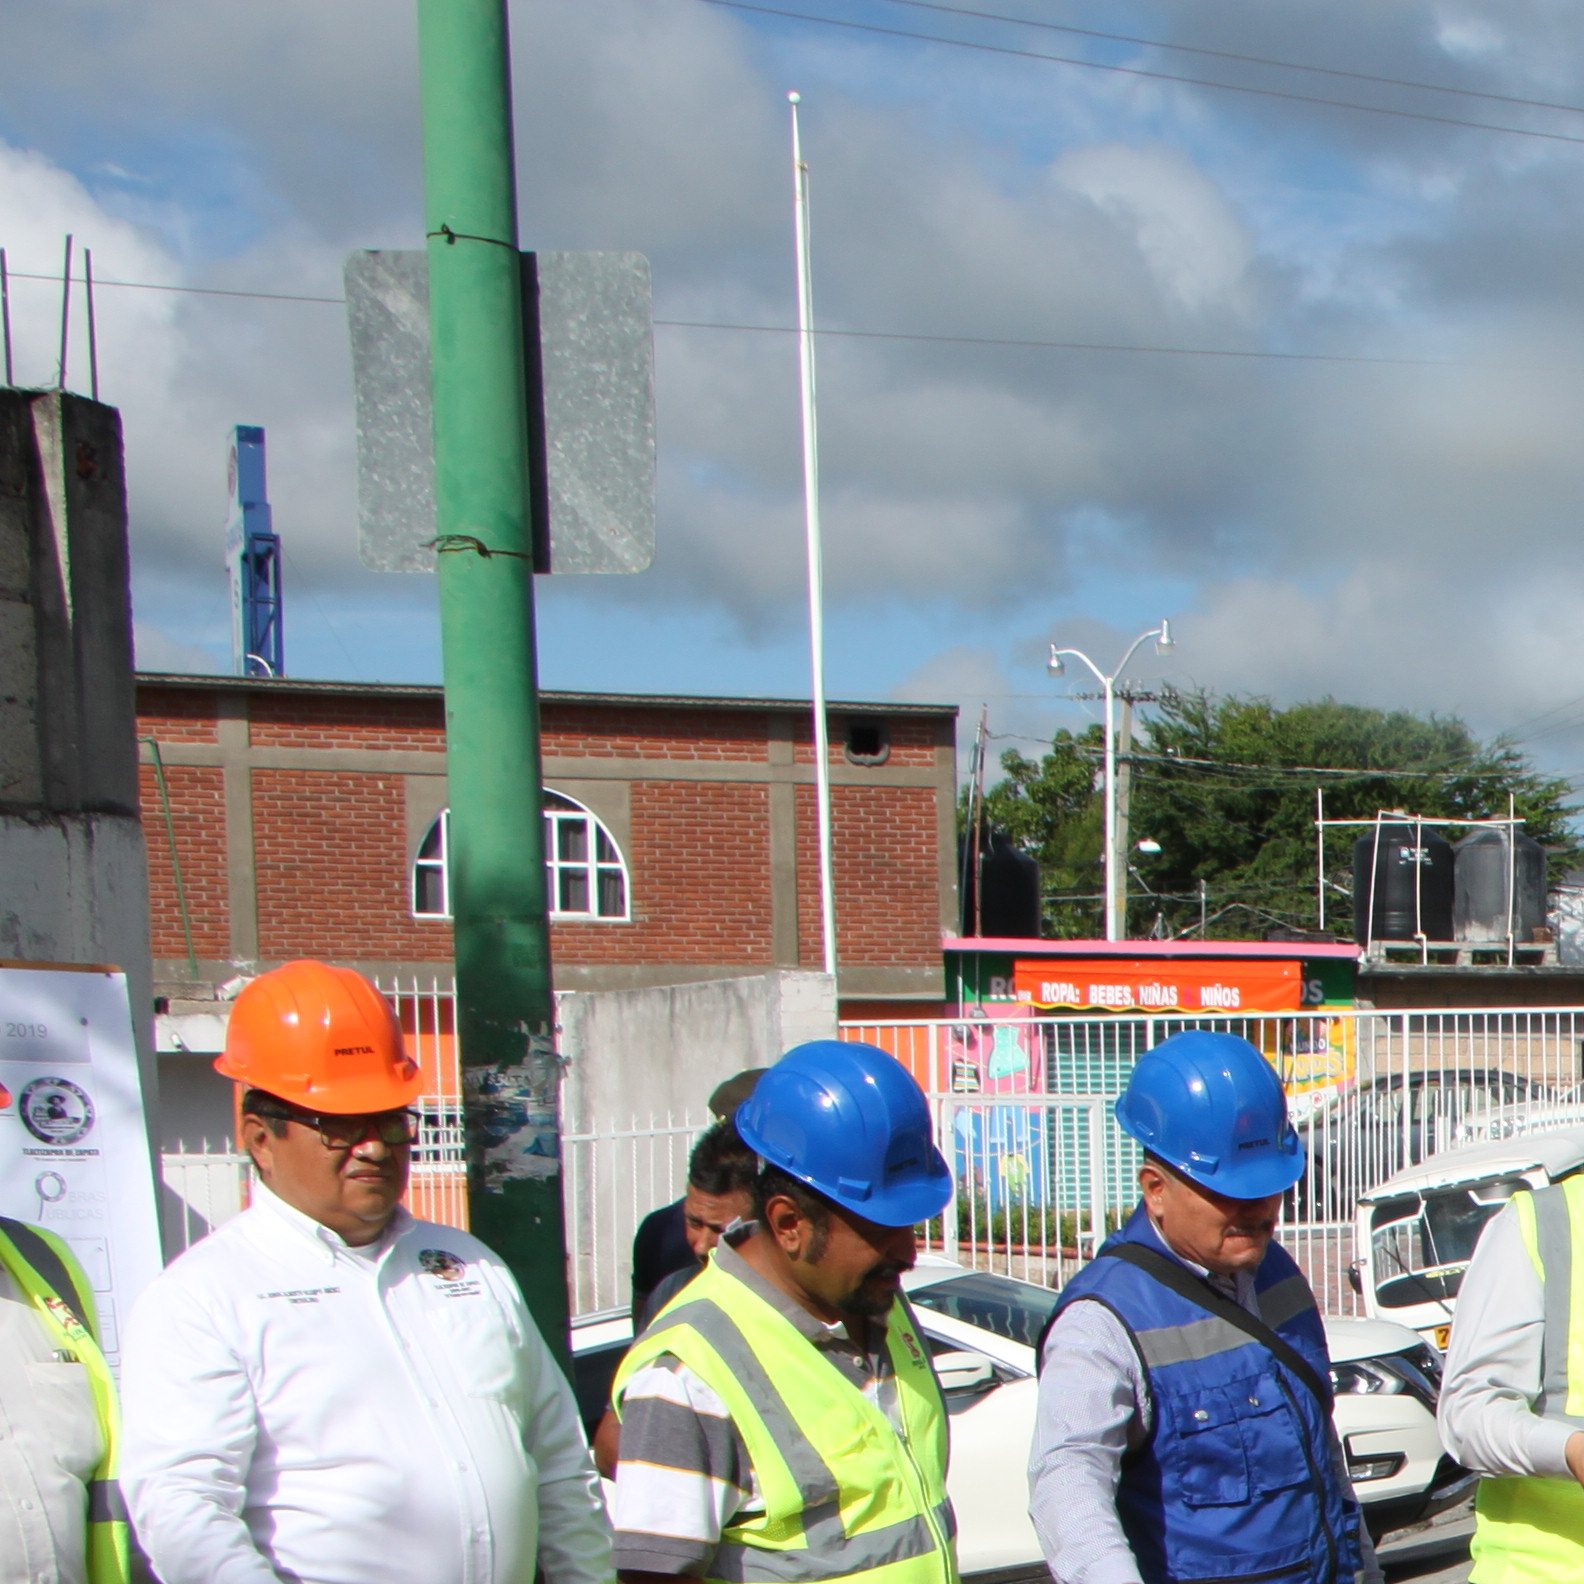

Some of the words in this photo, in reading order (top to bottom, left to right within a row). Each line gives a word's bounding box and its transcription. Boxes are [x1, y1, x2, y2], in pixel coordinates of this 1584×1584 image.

[1041, 982, 1080, 1003] ROPA:
[1089, 983, 1135, 1006] BEBES,
[1139, 982, 1178, 1006] NIÑAS
[1200, 983, 1240, 1007] NIÑOS
[7, 1022, 48, 1039] 2019
[334, 1046, 376, 1057] PRETUL
[1238, 1138, 1270, 1150] PRETUL
[1438, 1328, 1449, 1343] 7
